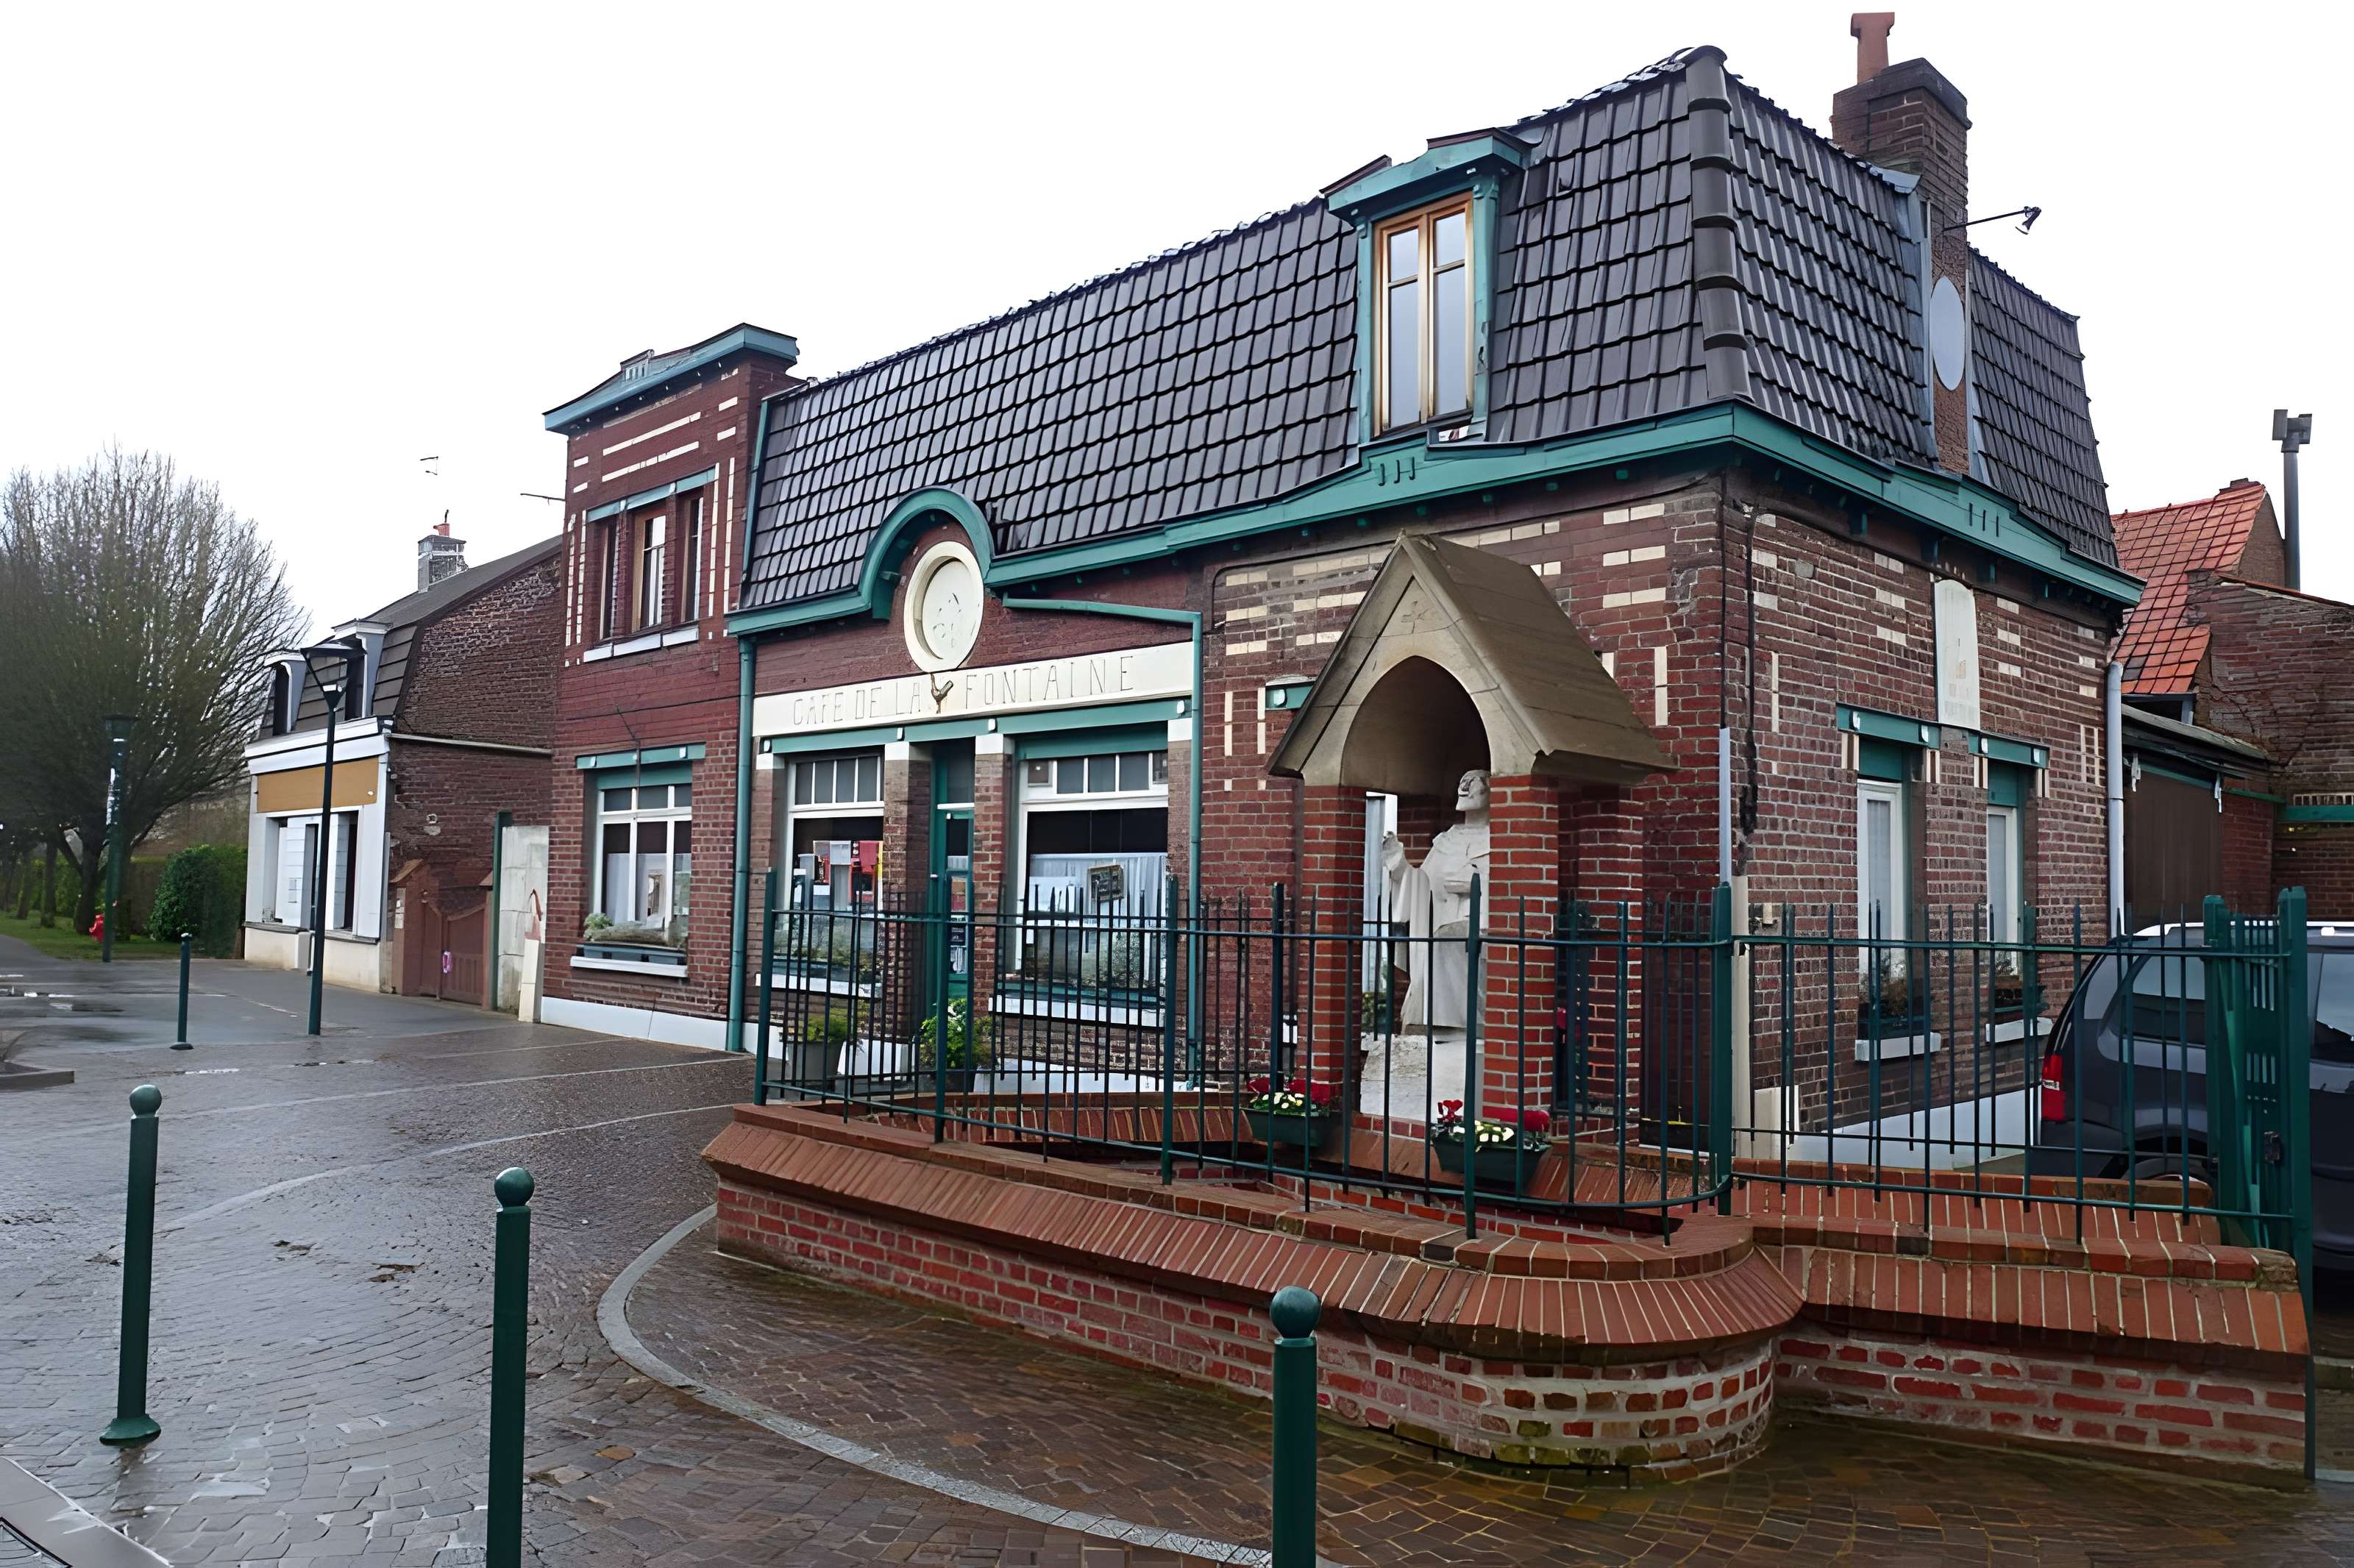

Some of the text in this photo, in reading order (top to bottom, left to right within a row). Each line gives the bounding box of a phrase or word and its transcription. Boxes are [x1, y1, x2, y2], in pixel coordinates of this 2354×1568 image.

[793, 655, 1134, 725] CAFE DE LA FONTAINE
